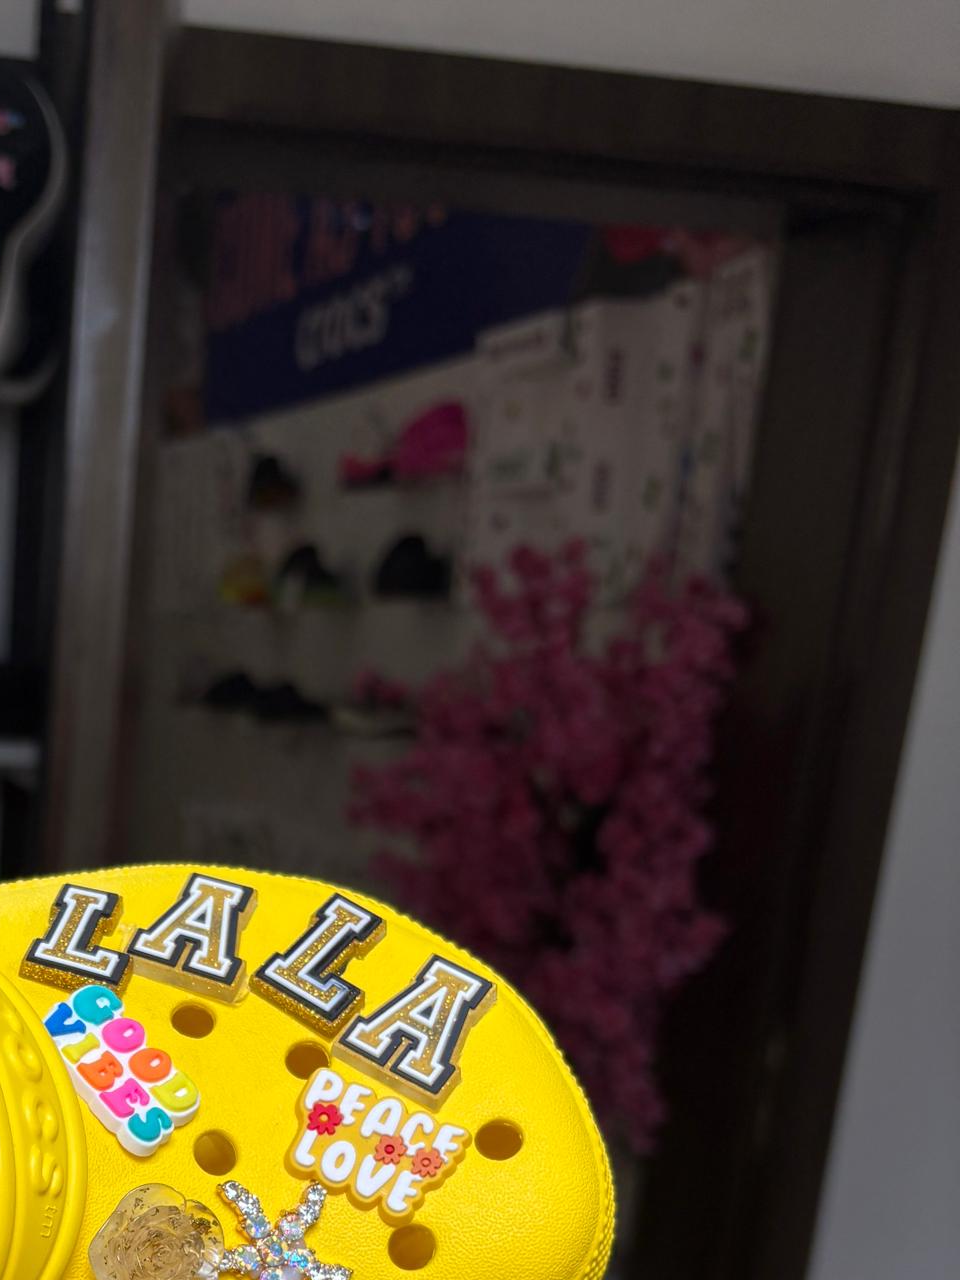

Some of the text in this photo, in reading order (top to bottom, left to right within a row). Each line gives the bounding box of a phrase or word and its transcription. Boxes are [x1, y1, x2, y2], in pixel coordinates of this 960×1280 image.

[20, 872, 496, 1098] LALA
[72, 984, 200, 1113] GOOD
[43, 1001, 174, 1143] VIBES
[304, 1068, 466, 1164] PEACE
[294, 1129, 425, 1212] LOVE
